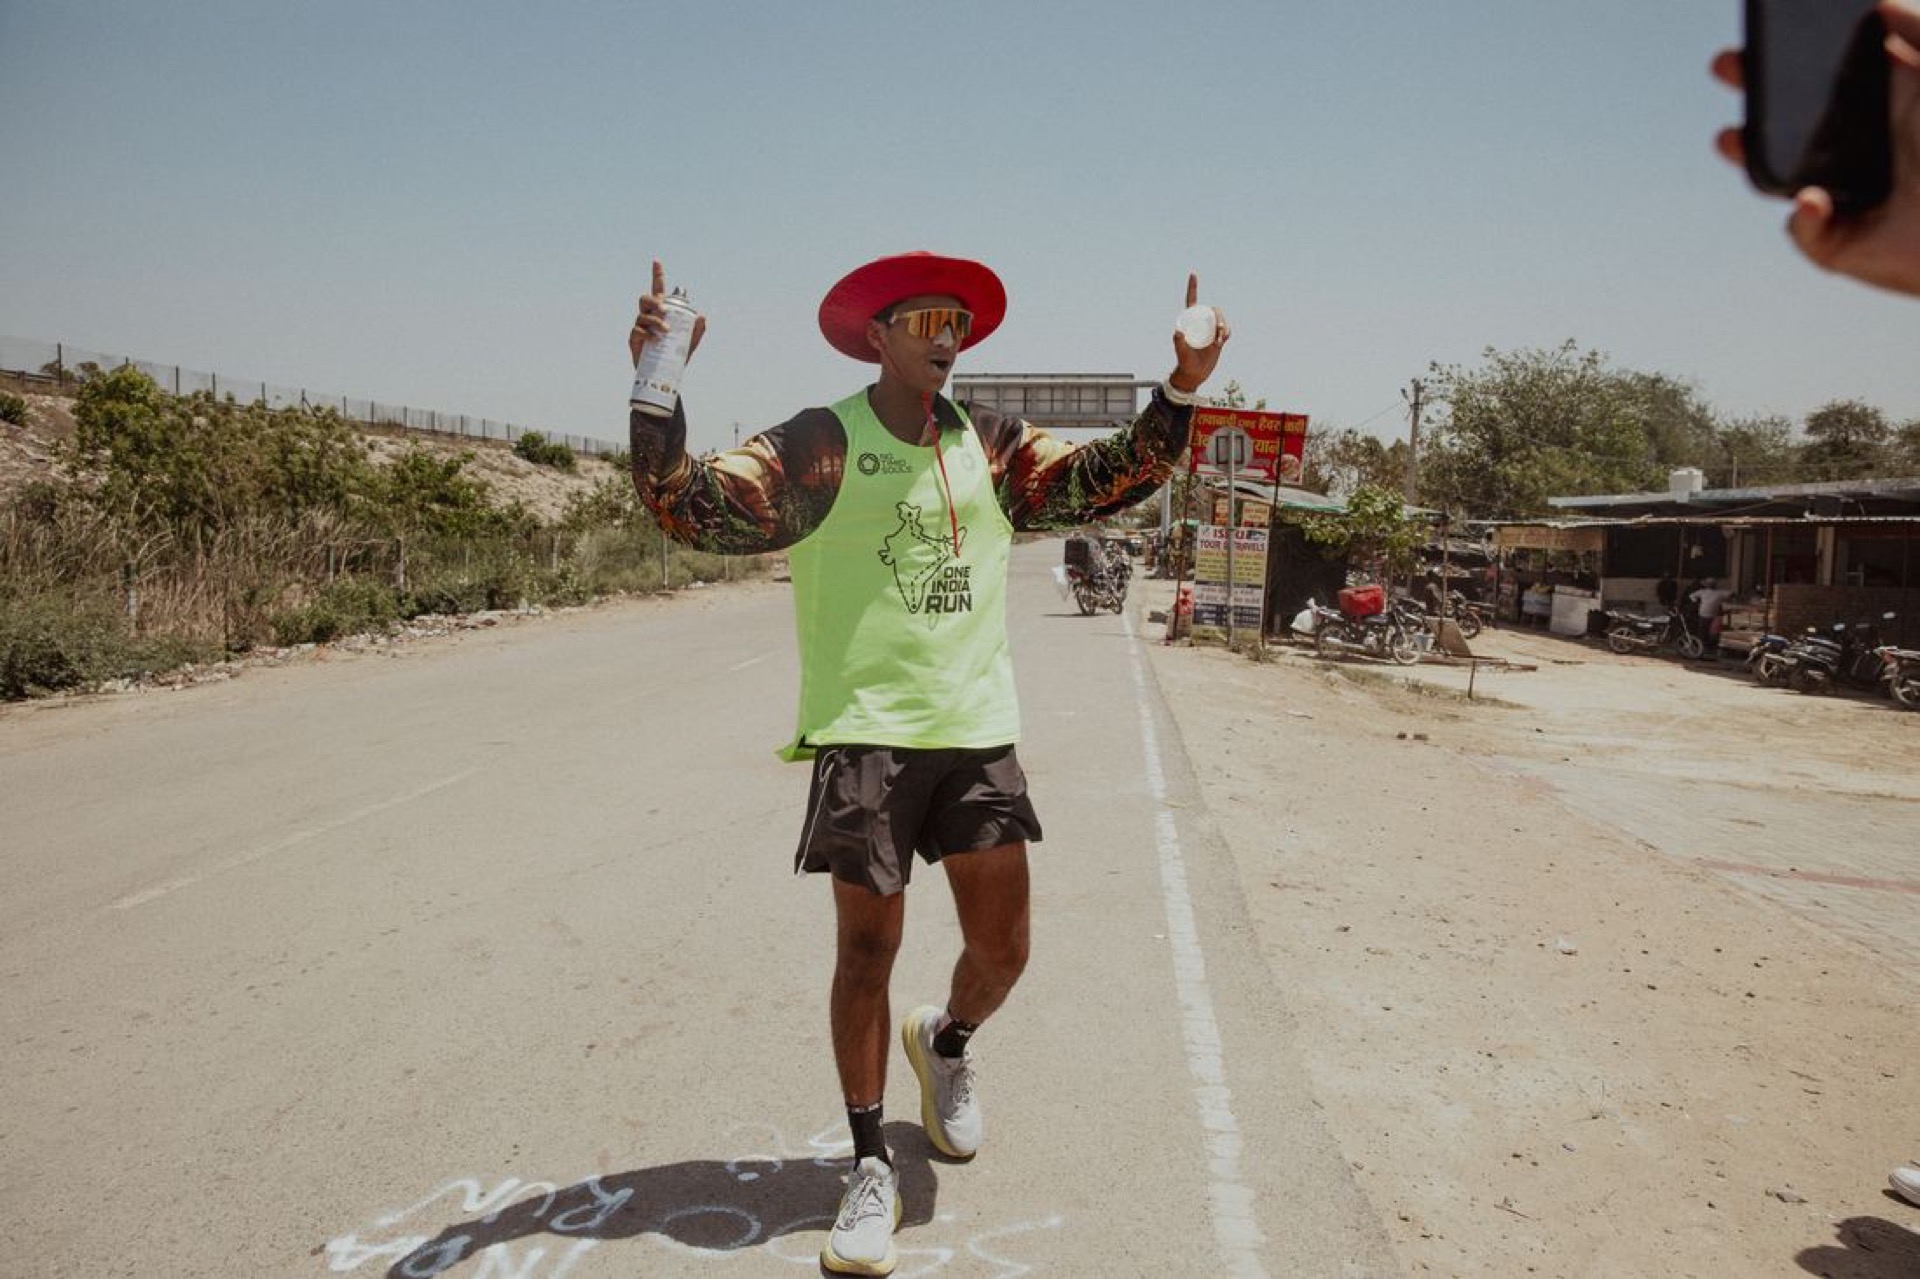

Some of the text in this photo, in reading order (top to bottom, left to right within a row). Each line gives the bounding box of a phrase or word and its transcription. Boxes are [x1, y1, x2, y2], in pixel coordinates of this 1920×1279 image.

[1200, 541, 1221, 550] TOUR
[944, 566, 971, 578] ONE
[931, 579, 970, 593] INDIA
[925, 593, 972, 614] RUN
